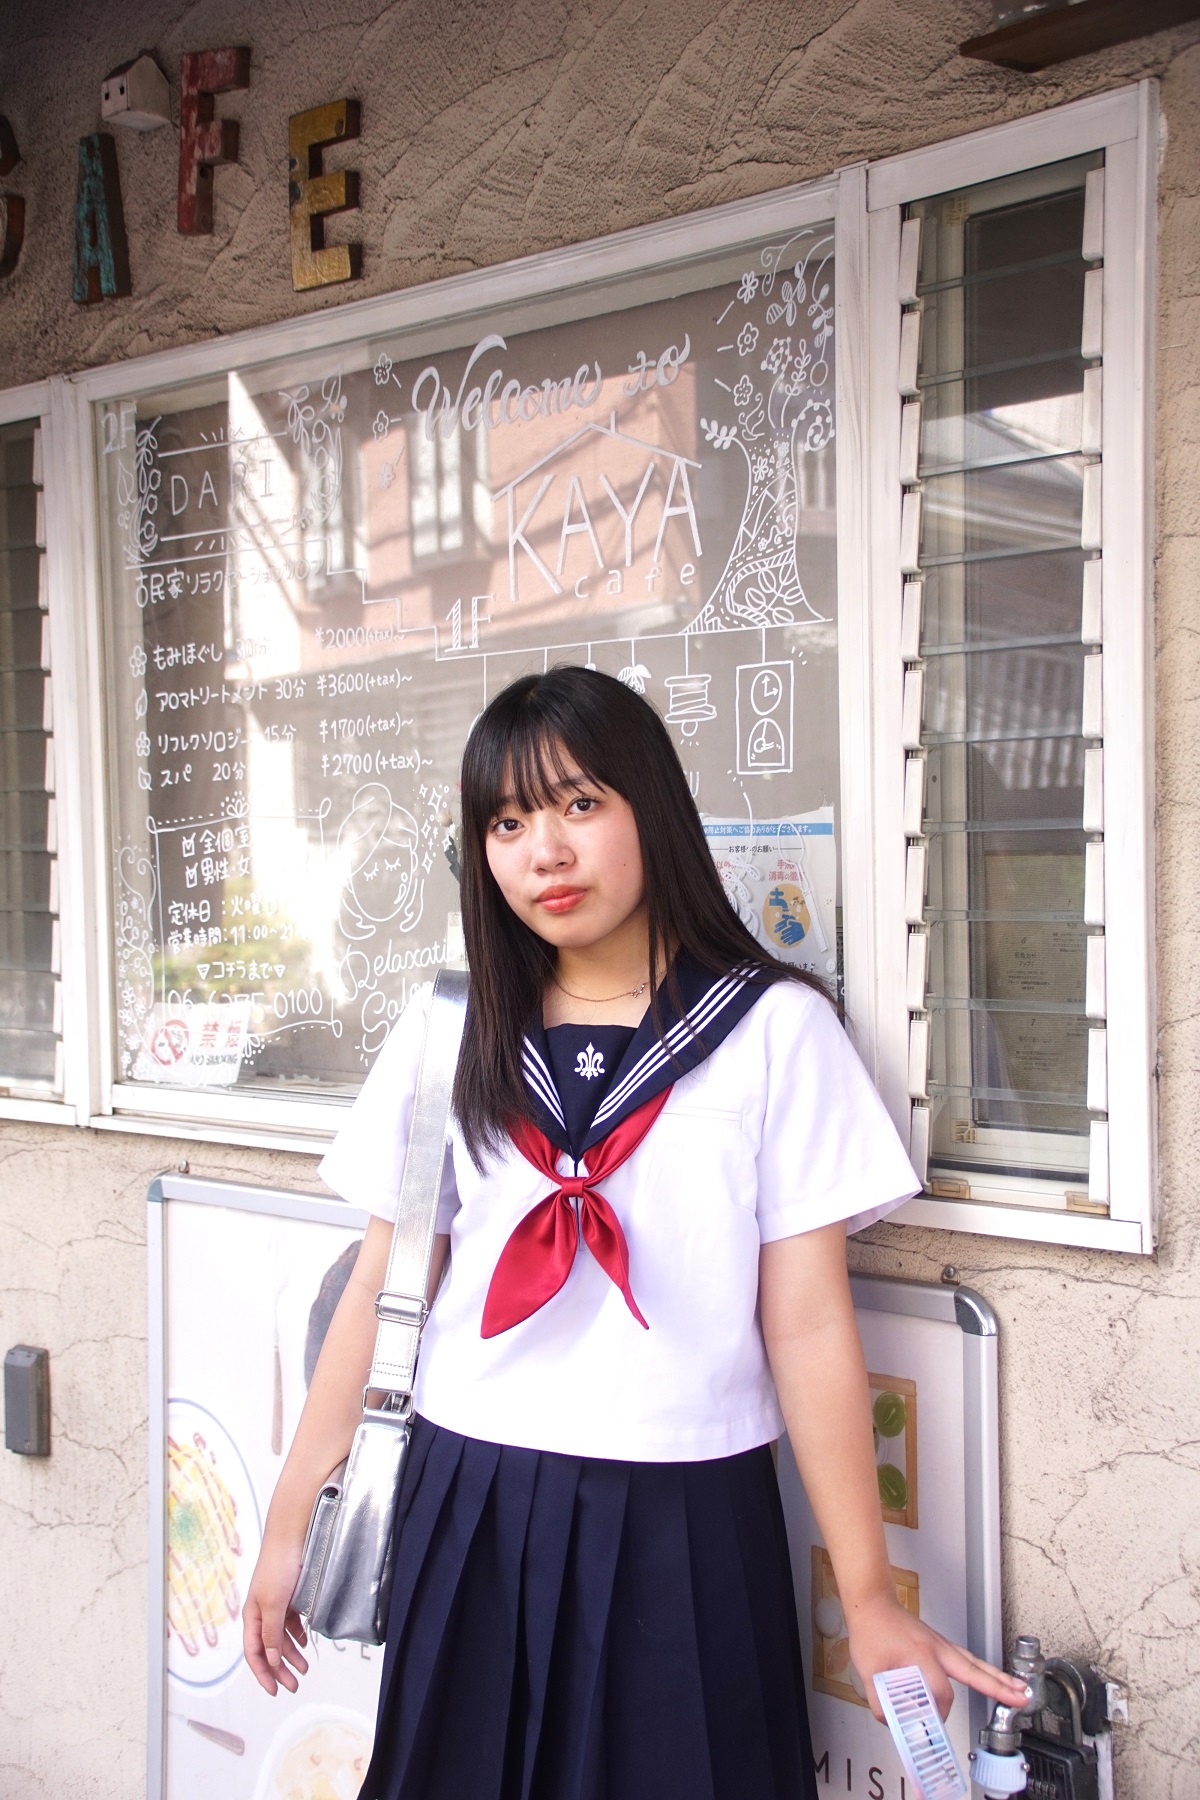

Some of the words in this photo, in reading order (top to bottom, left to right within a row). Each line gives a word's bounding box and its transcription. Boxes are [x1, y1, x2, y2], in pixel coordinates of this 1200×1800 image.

[412, 334, 602, 442] Welcome
[622, 333, 691, 397] to
[101, 401, 138, 454] 2F
[507, 457, 703, 602] KAYA
[574, 562, 696, 599] cafe
[445, 594, 496, 653] 1F
[153, 643, 223, 676] もみほぐし
[156, 685, 268, 712] アロマトリートメント
[275, 679, 307, 701] 30分
[158, 728, 252, 754] リフレクソロジー
[264, 723, 297, 743] 15分
[160, 763, 192, 787] スパ
[212, 761, 246, 782] 20分
[339, 938, 449, 1001] Relaxati
[361, 976, 432, 1053] Salo
